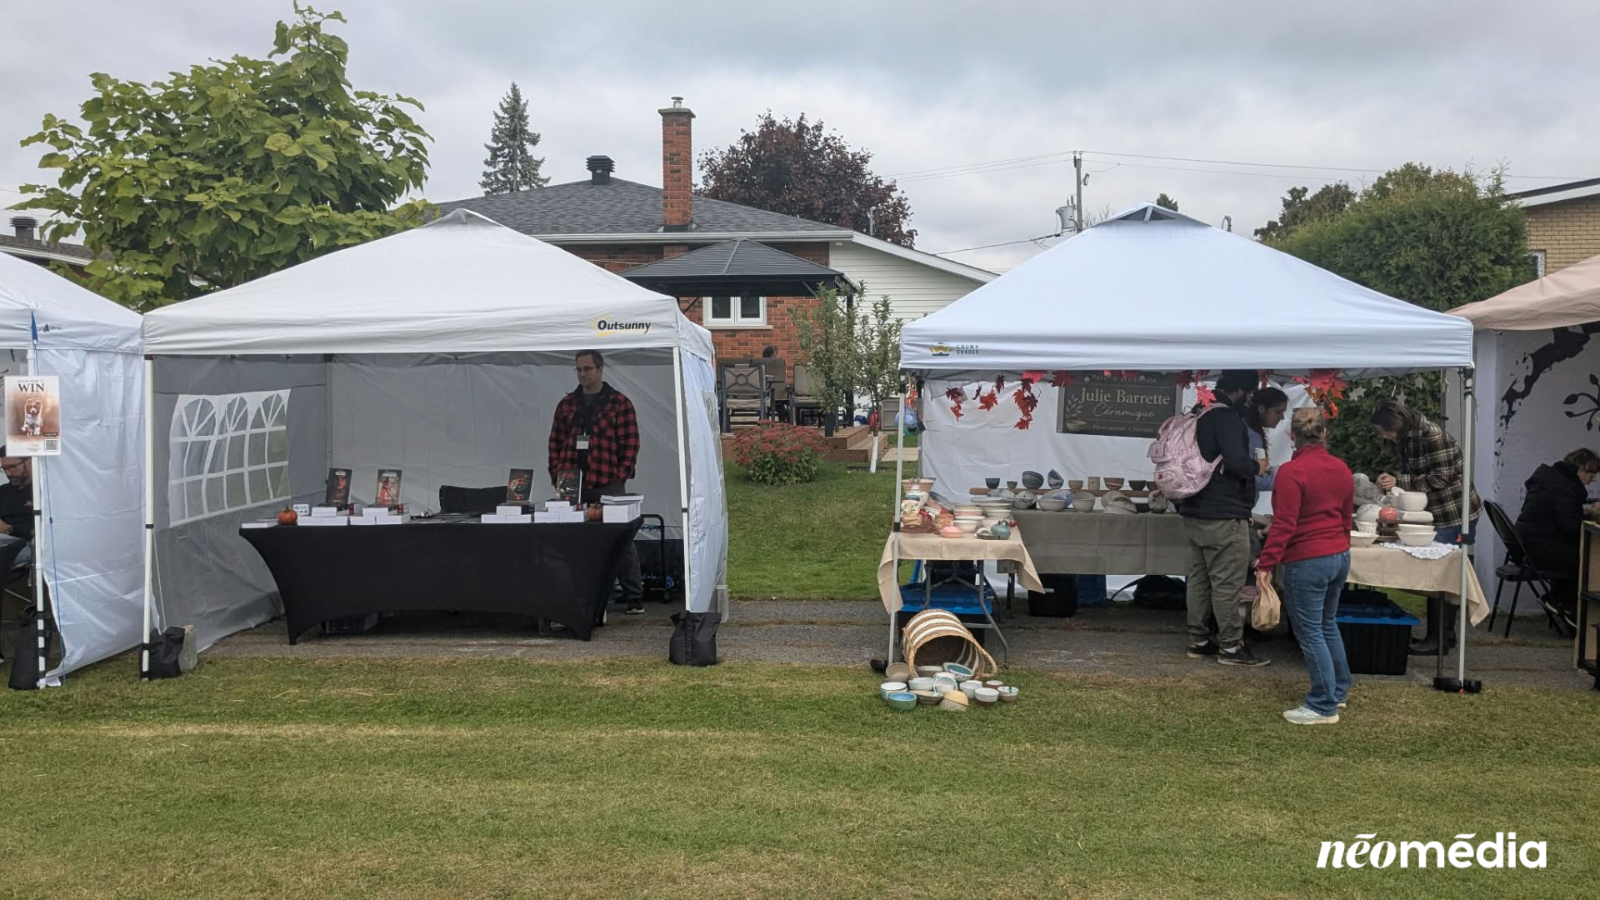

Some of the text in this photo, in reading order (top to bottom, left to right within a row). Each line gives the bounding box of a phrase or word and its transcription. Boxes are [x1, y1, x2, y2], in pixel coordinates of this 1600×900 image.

[597, 319, 651, 335] Outsunny
[18, 383, 46, 393] WIN
[1081, 387, 1171, 406] Julie Barrette
[1093, 402, 1156, 421] Céramique
